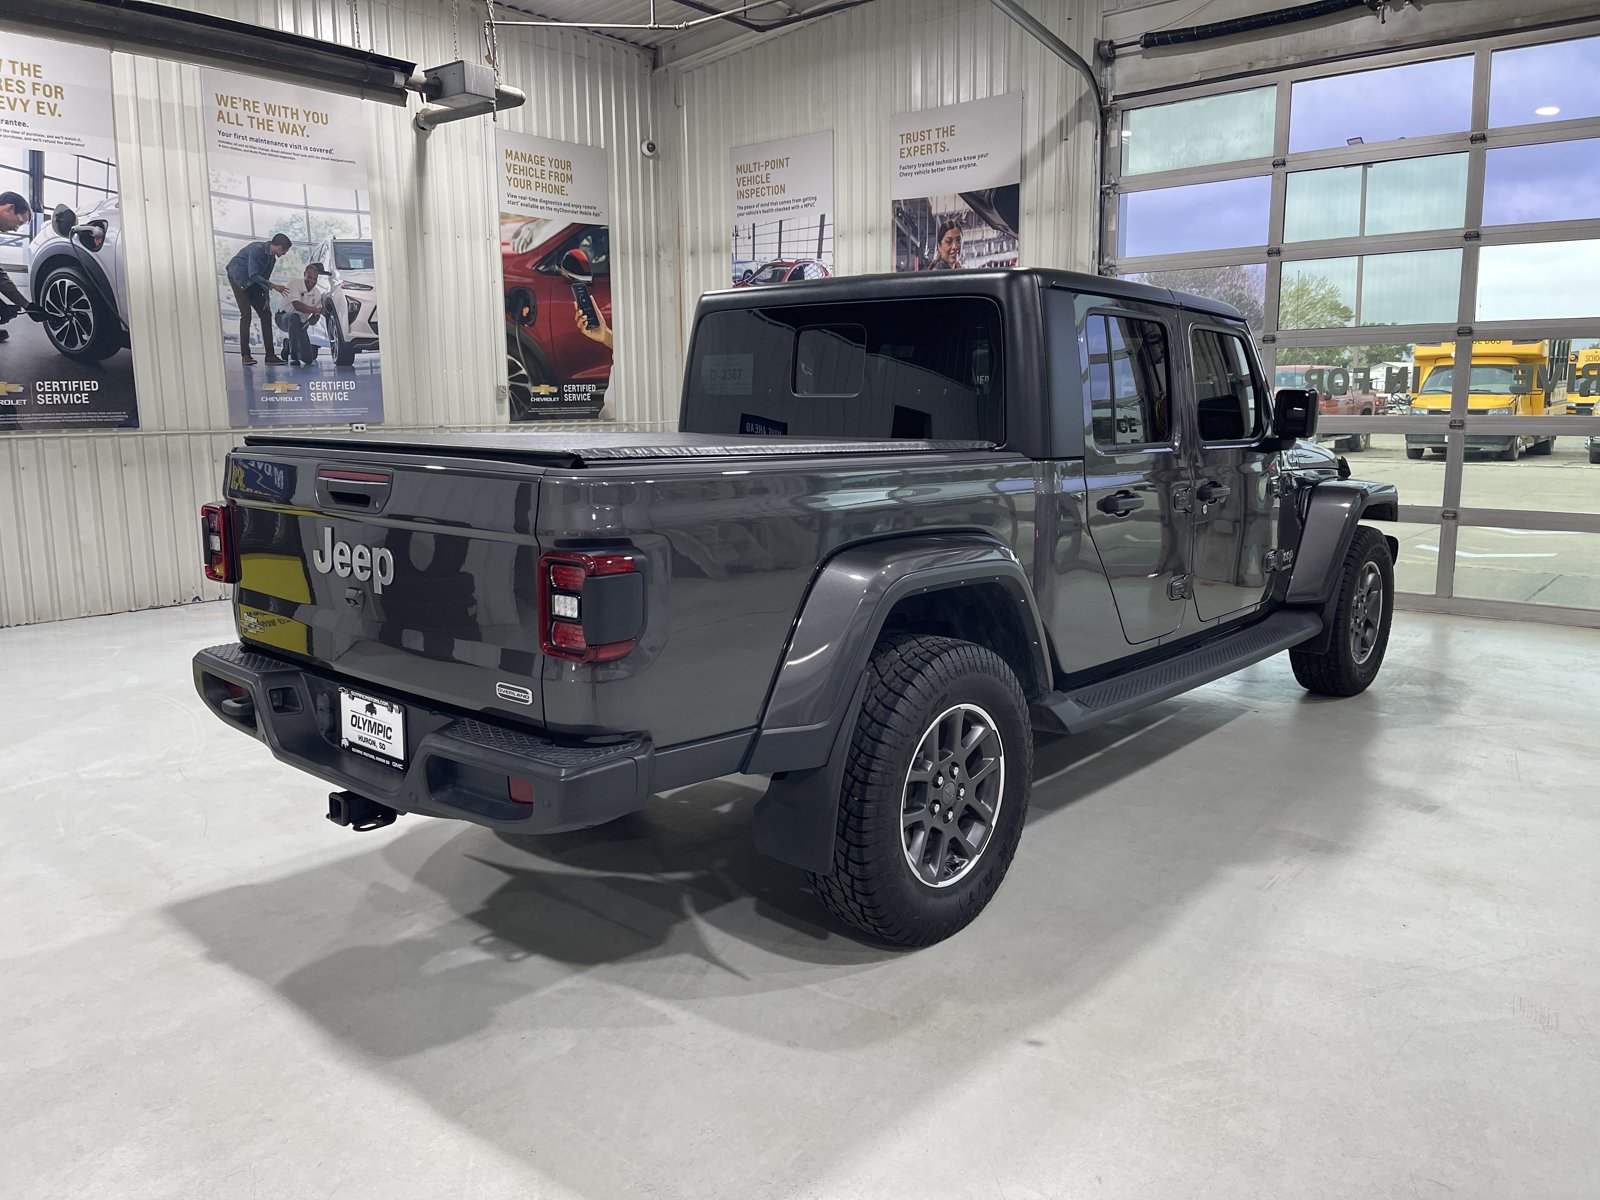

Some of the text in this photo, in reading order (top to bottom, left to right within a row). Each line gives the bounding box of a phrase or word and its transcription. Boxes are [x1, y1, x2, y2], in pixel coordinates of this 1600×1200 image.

[8, 59, 43, 79] THE
[32, 81, 65, 100] FOR
[36, 100, 62, 117] EV.
[215, 92, 329, 126] WE'RE WITH YOU
[216, 110, 310, 138] ALL THE WAY.
[217, 129, 232, 138] Your
[233, 132, 248, 141] first
[249, 136, 288, 149] maintenance
[289, 142, 302, 150] visit
[899, 125, 956, 145] TRUST THE
[899, 141, 950, 159] EXPERTS.
[935, 157, 962, 166] technicians
[977, 152, 989, 160] your
[505, 148, 572, 171] MANAGE YOUR
[736, 157, 790, 175] MULTI-POINT
[505, 162, 573, 184] VEHICLE FROM
[736, 173, 771, 187] VEHICLE
[506, 175, 568, 196] YOUR PHONE.
[736, 183, 786, 200] INSPECTION
[35, 380, 99, 392] CERTIFIED
[309, 380, 356, 391] CERTIFIED
[563, 384, 596, 392] CERTIFIED
[37, 393, 90, 405] SERVICE
[310, 391, 349, 401] SERVICE
[563, 393, 591, 401] SERVICE
[313, 527, 394, 594] Jeep
[350, 714, 393, 741] OLYMPIC
[358, 734, 386, 751] HURON, SD
[391, 761, 404, 770] GMC
